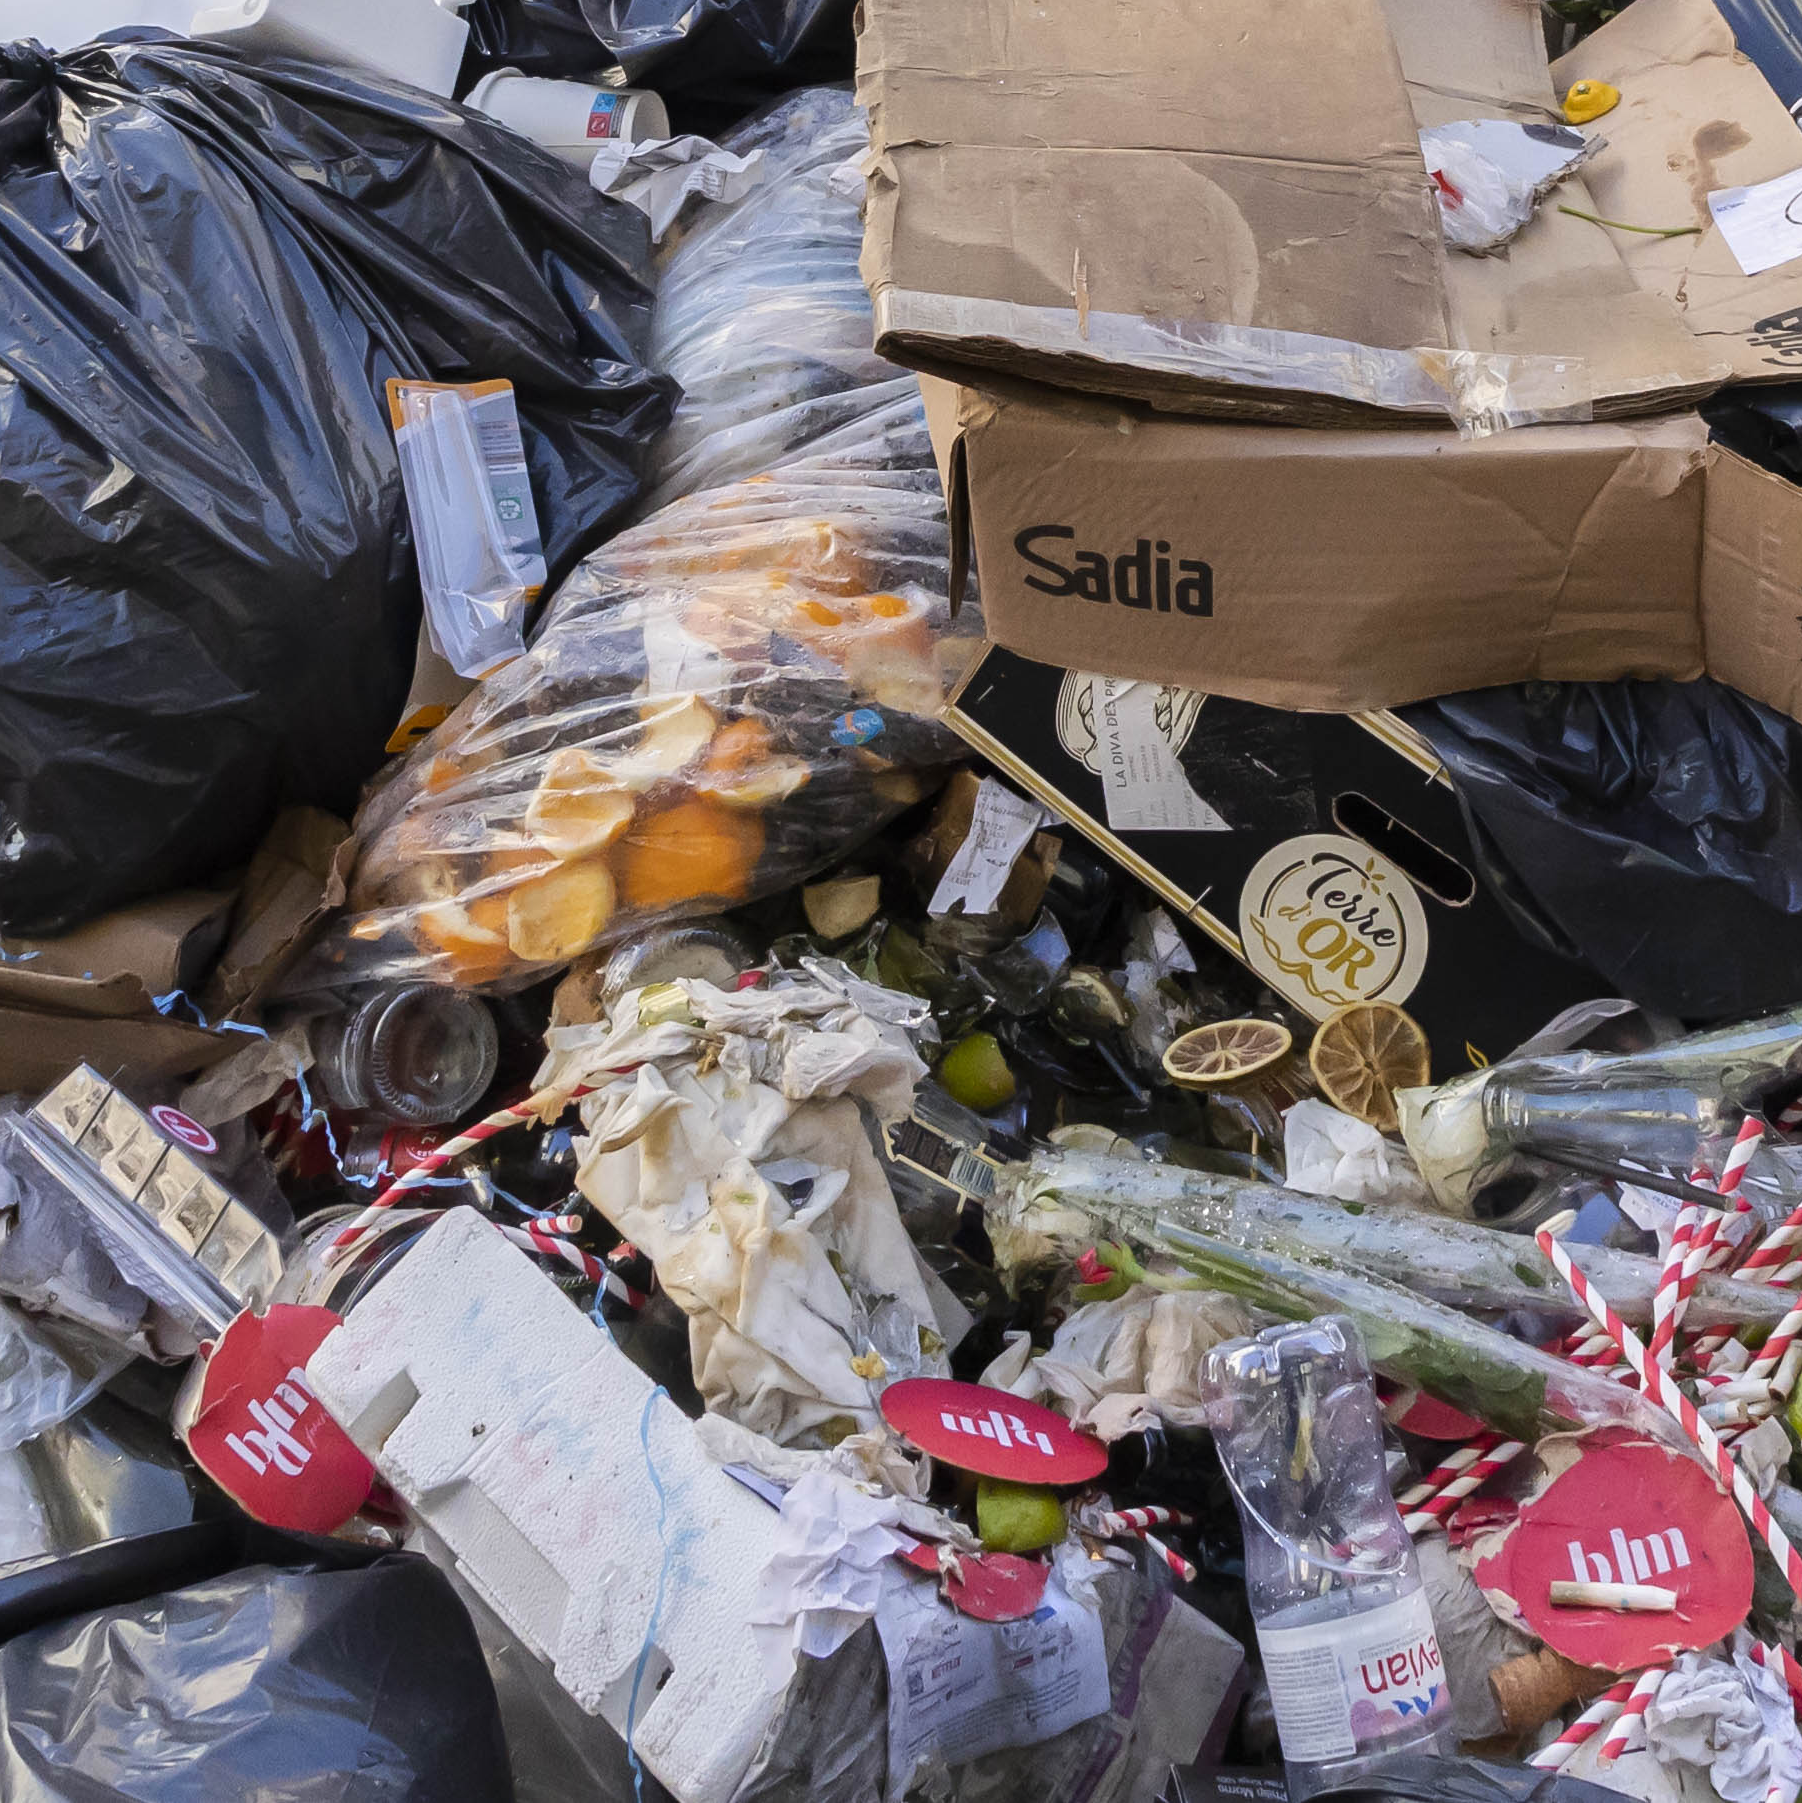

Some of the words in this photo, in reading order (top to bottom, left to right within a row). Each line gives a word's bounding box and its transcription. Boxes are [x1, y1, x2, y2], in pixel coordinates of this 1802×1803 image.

[1013, 524, 1215, 619] Sadia
[1109, 731, 1125, 766] DIVA
[1116, 769, 1128, 789] LA
[1306, 852, 1397, 947] Terre
[1360, 1634, 1442, 1695] evian
